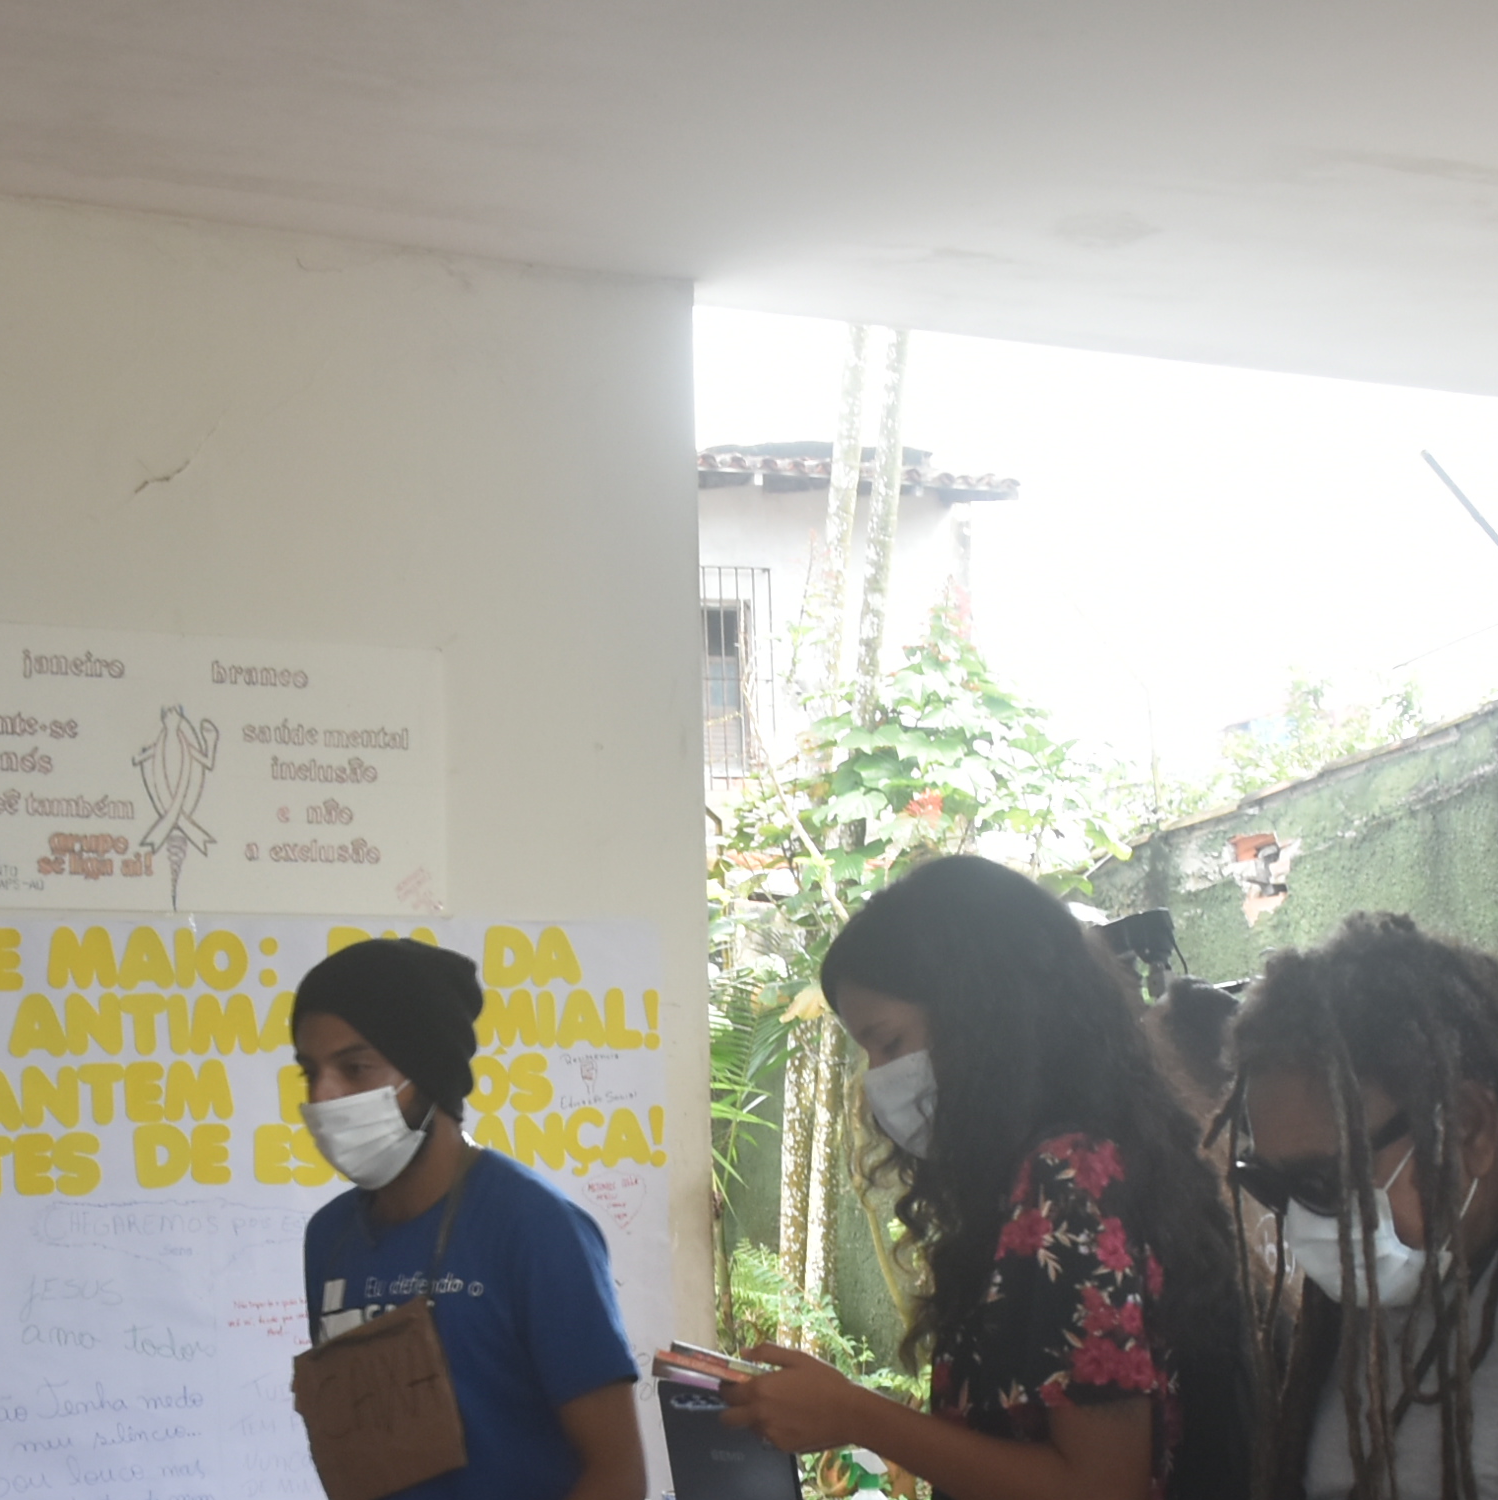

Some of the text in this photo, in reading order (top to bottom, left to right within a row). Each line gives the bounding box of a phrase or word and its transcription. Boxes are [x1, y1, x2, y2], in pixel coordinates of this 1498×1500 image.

[22, 649, 309, 688] janeiro branco
[324, 725, 409, 750] mental
[271, 755, 378, 784] inclusão
[25, 793, 134, 820] também
[307, 798, 354, 825] não
[37, 855, 65, 875] se
[245, 839, 381, 864] a exclusão
[47, 925, 278, 992] MAIO:
[483, 925, 582, 989] DA
[132, 1123, 231, 1189] DE
[365, 1276, 383, 1298] Eu
[468, 1281, 484, 1297] o
[142, 1384, 205, 1410] medo
[13, 1434, 75, 1453] meu
[66, 1455, 146, 1487] louco
